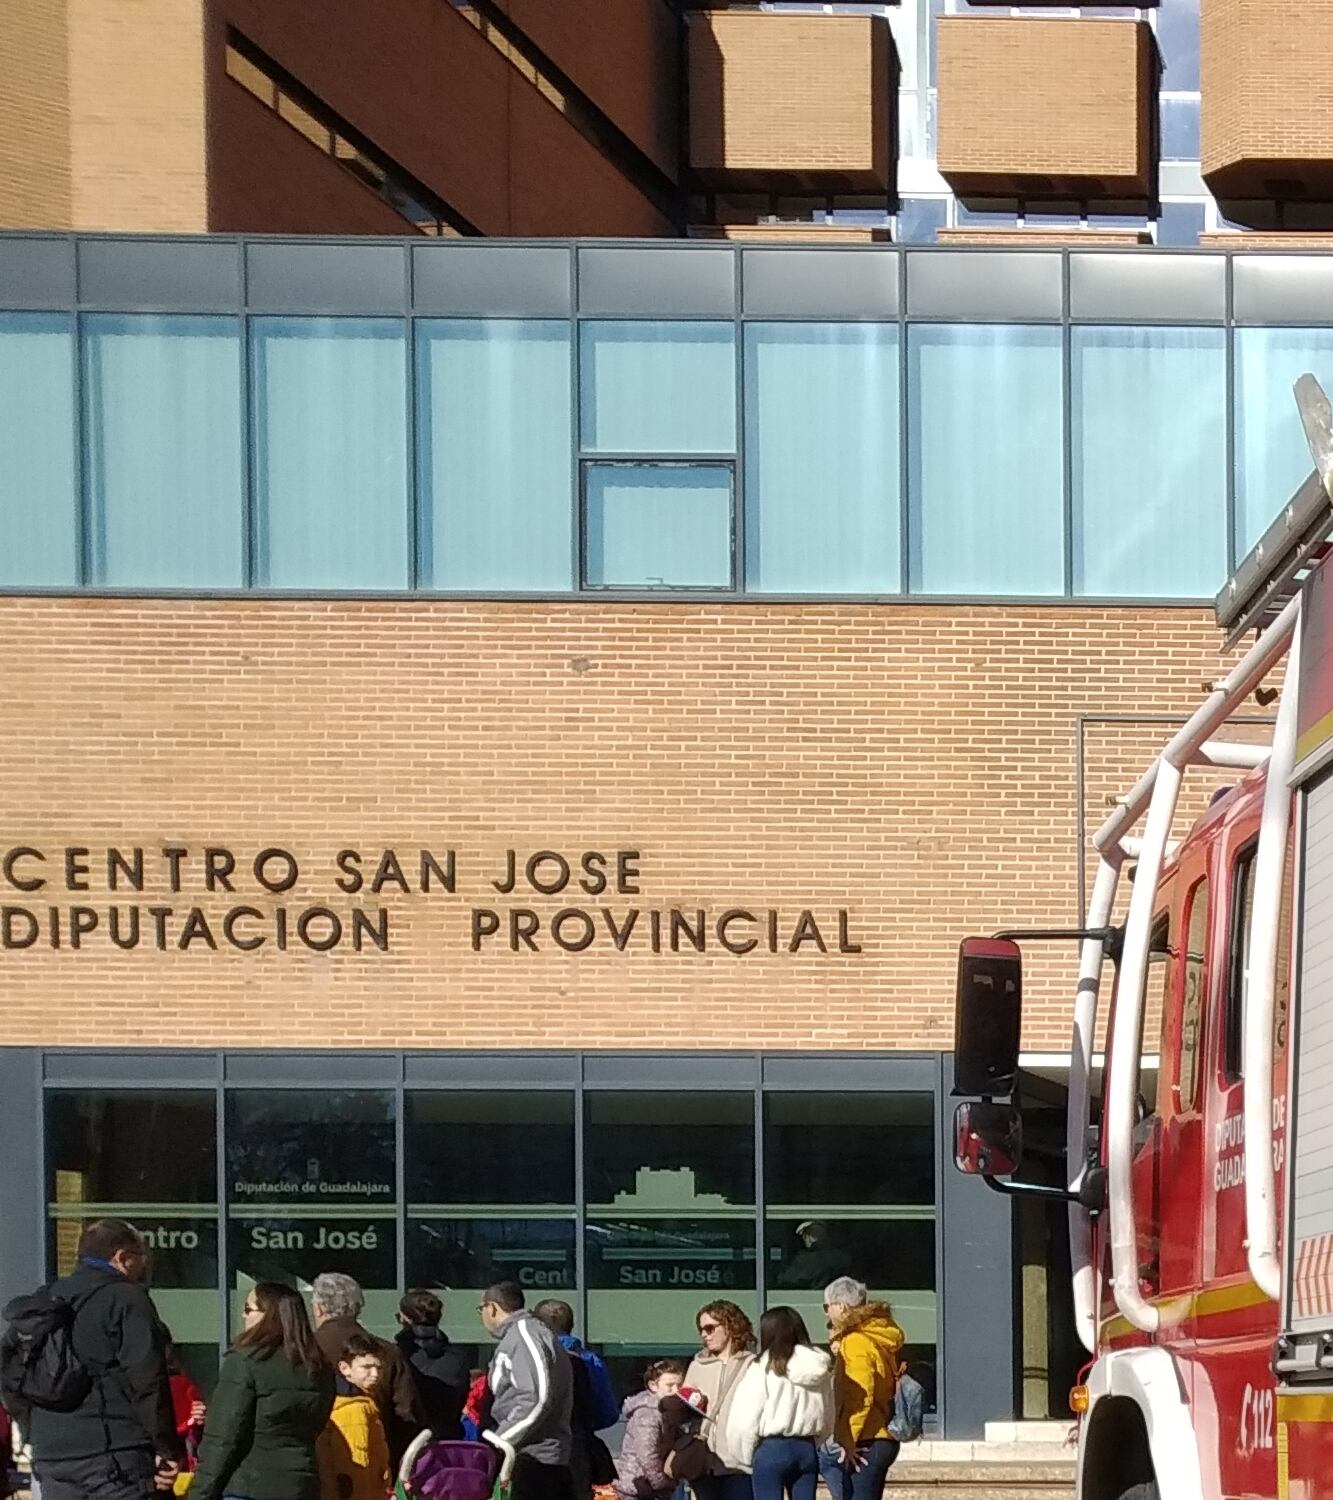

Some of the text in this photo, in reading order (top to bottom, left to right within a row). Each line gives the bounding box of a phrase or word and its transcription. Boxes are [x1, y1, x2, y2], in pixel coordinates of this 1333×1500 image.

[2, 845, 643, 897] CENTRO SAN JOSE
[2, 905, 865, 957] DIPUTACION PROVINCIAL
[234, 1180, 391, 1197] Diputación de Guadalajara
[143, 1225, 378, 1250] ntro San José
[618, 1265, 663, 1284] San
[667, 1264, 721, 1285] José
[1253, 1388, 1273, 1449] 112
